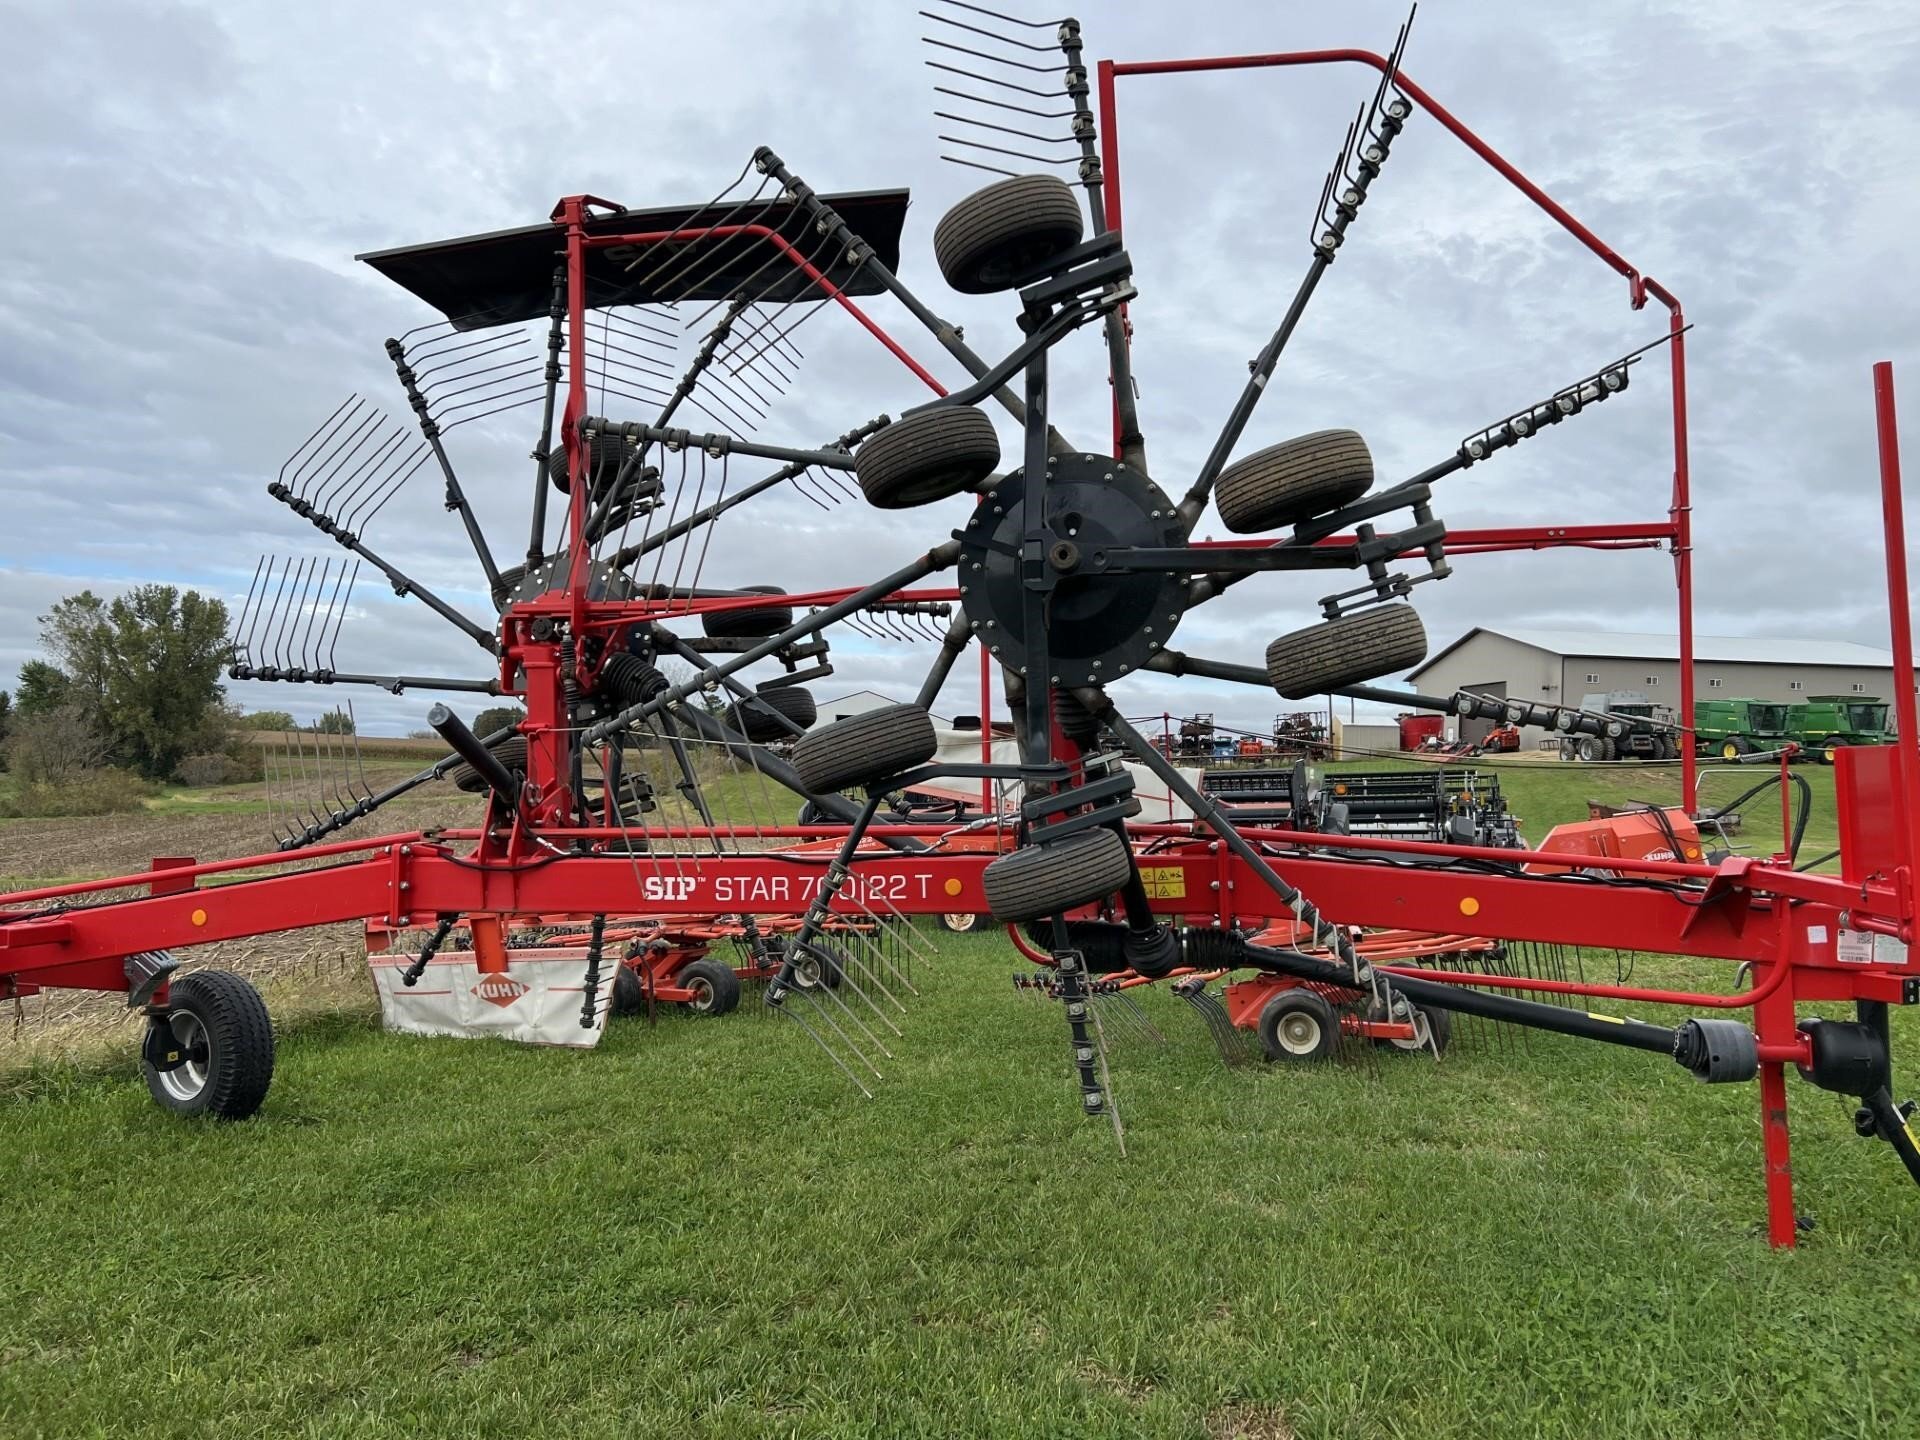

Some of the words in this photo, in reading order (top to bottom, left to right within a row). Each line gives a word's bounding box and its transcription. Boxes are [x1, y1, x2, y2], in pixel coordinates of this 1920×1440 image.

[715, 876, 789, 901] STAR
[914, 874, 933, 899] T
[476, 983, 525, 999] KUHN
